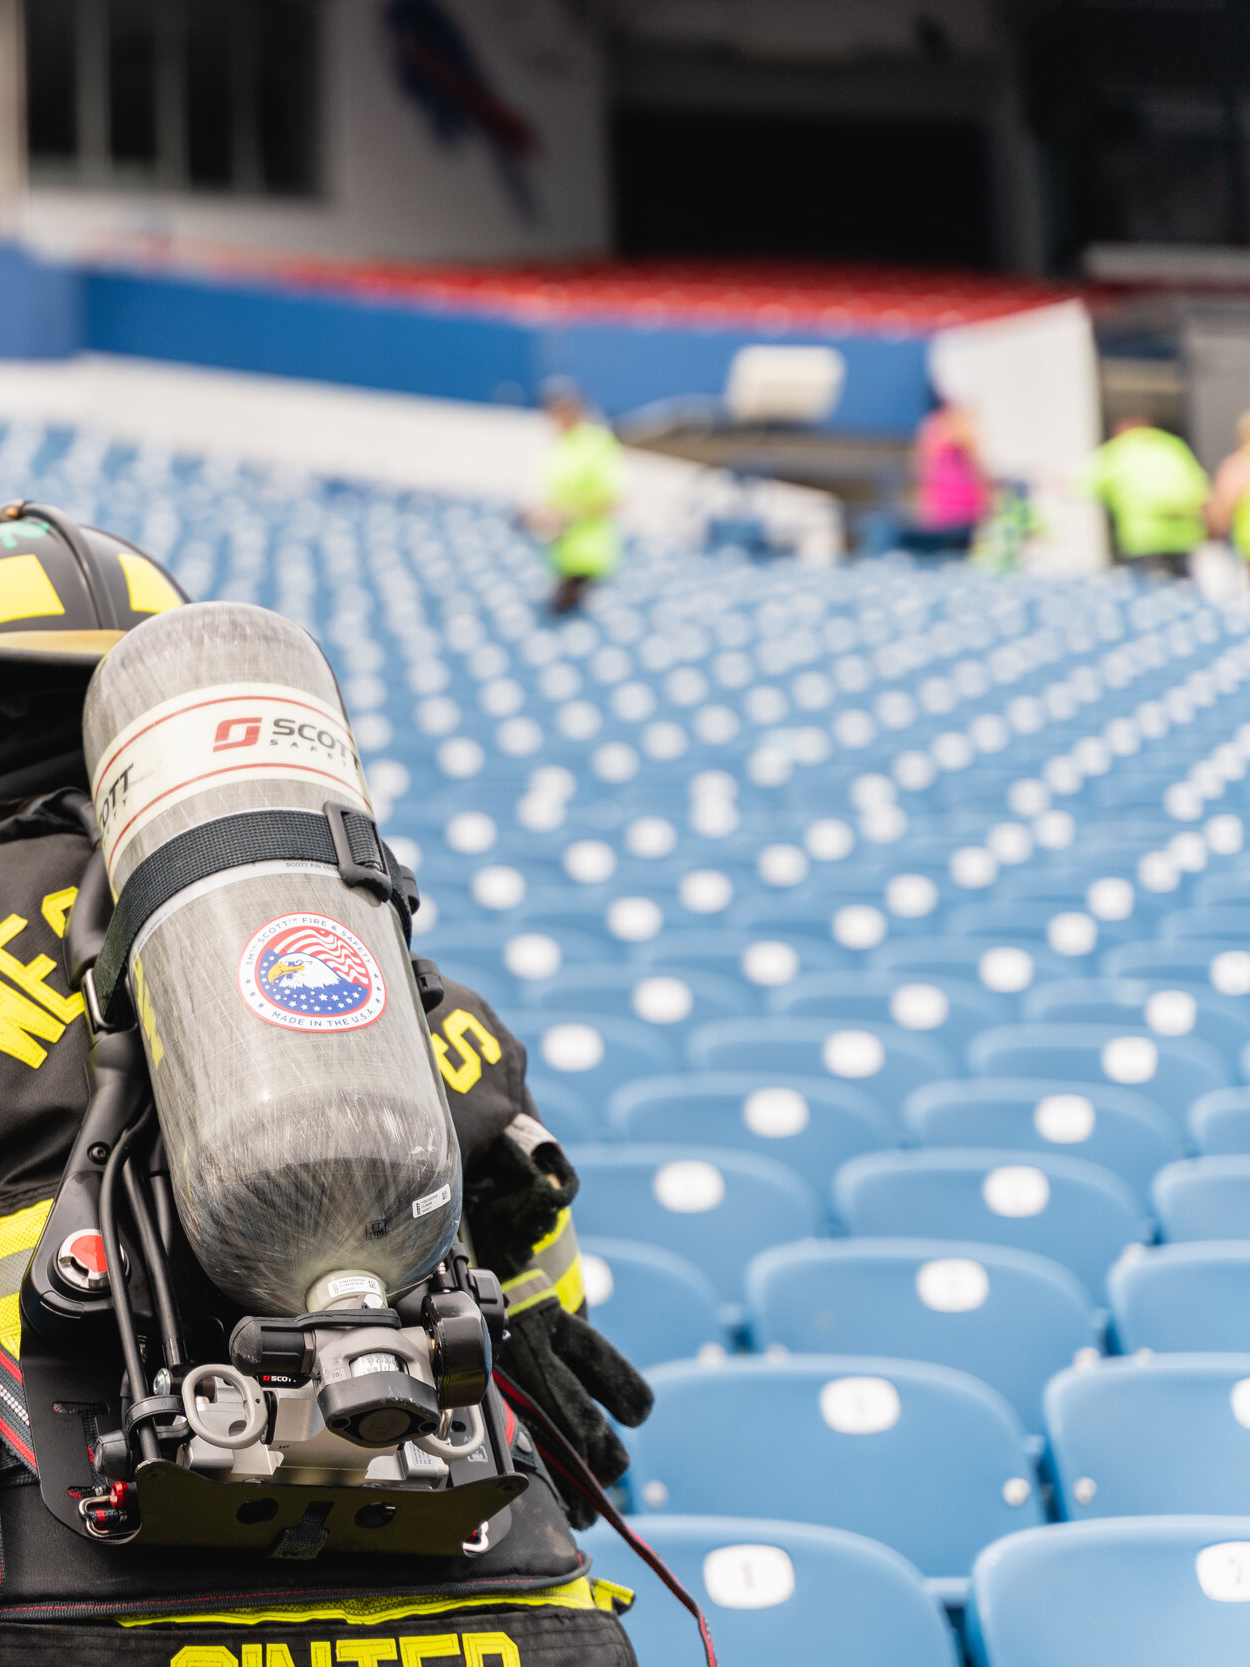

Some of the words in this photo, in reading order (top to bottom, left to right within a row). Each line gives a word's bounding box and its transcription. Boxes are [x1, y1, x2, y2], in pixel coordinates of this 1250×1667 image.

[100, 762, 134, 828] OTT
[302, 917, 327, 927] FIRE
[341, 931, 372, 964] SAFETY
[272, 1011, 304, 1026] MADE
[327, 1018, 349, 1027] THE
